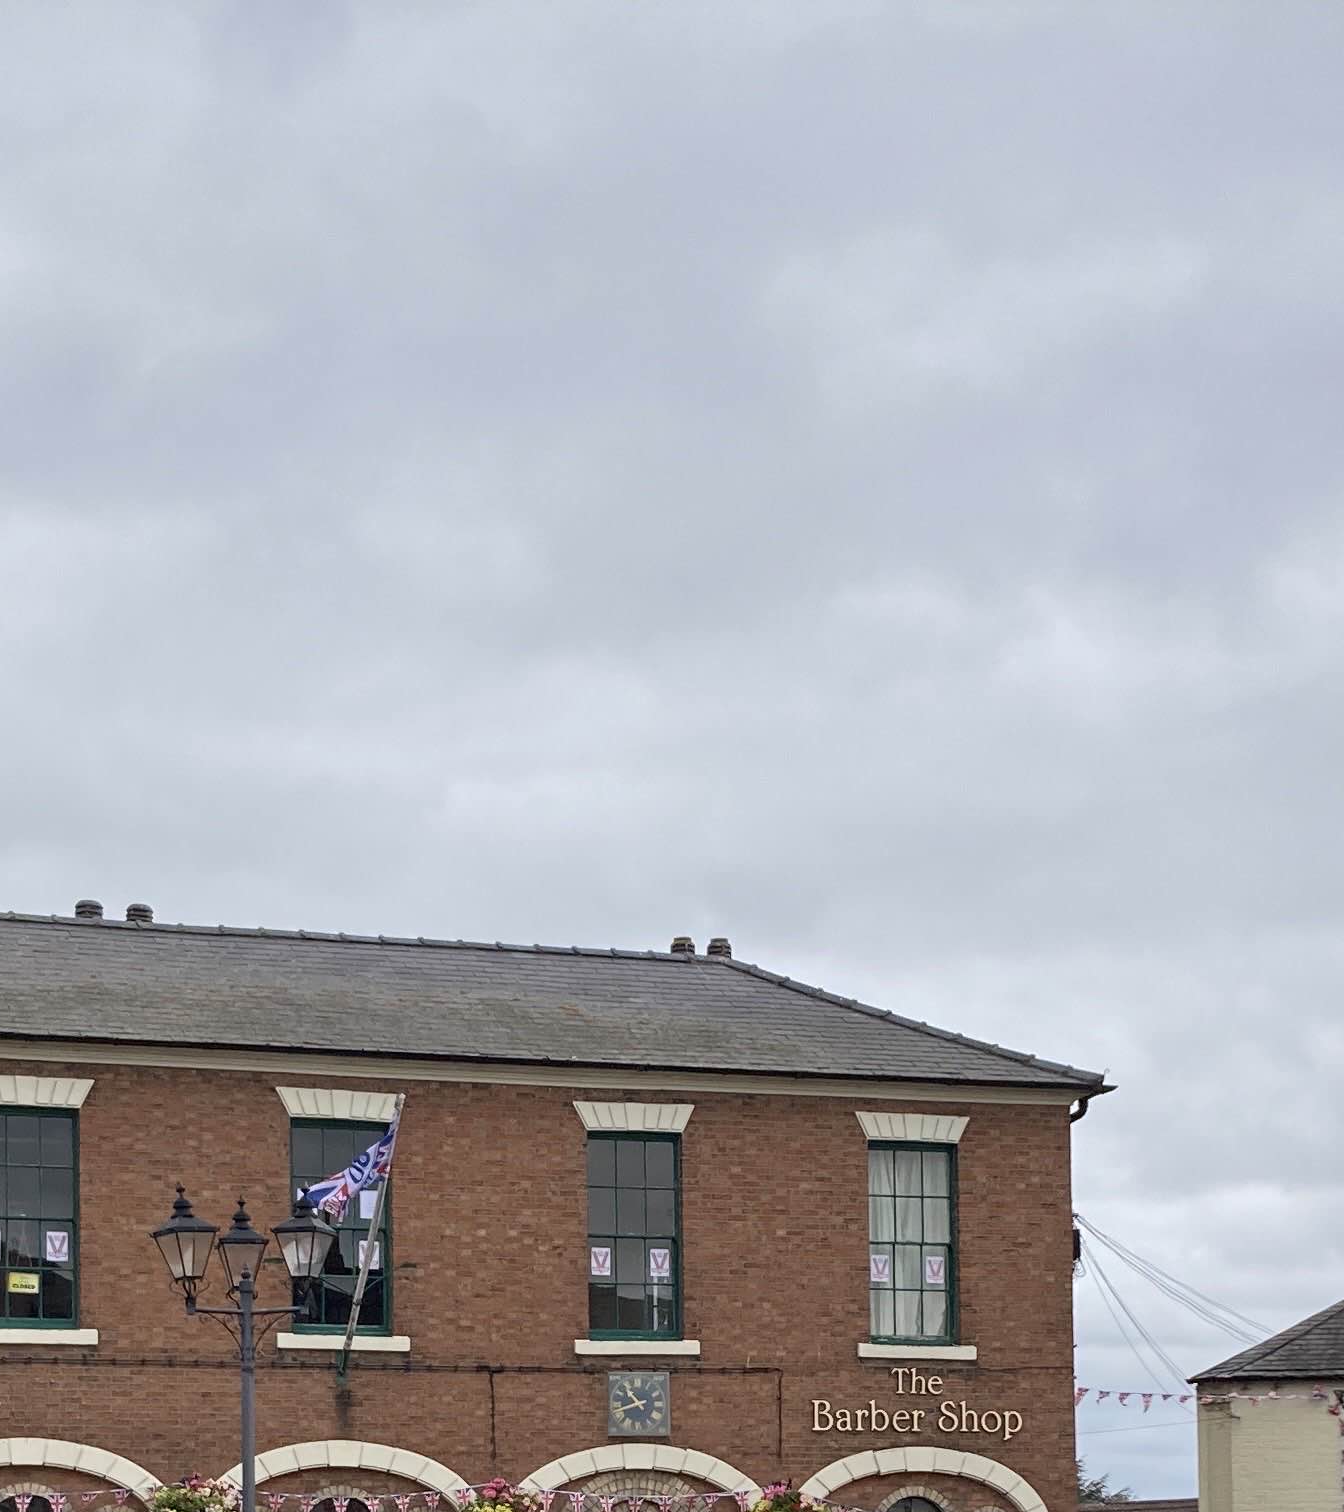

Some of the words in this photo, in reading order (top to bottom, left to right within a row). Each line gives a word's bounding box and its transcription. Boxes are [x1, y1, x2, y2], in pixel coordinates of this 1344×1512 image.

[891, 1367, 944, 1395] The
[811, 1399, 926, 1432] Barber
[938, 1400, 1023, 1441] Shop
